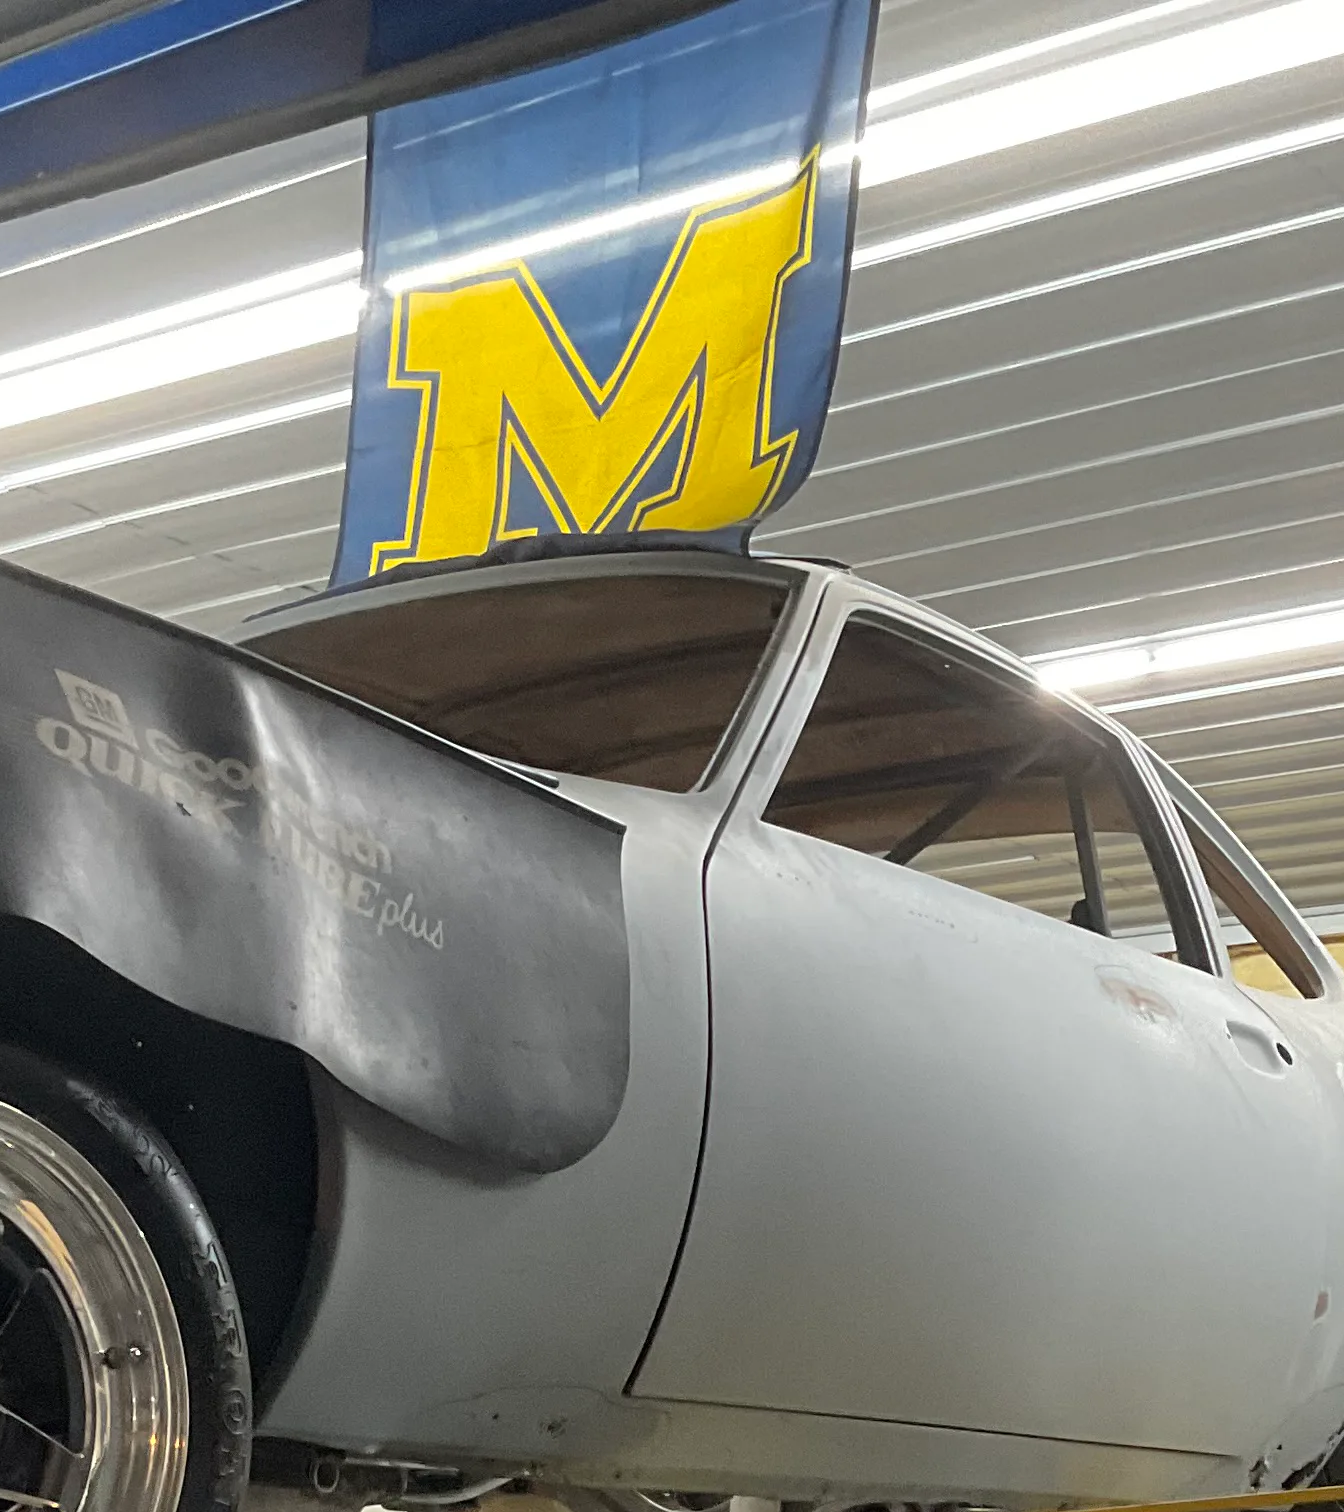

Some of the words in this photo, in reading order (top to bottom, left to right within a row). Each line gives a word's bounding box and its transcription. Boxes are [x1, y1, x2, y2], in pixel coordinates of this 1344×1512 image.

[369, 143, 822, 578] M
[75, 685, 121, 723] GM
[36, 716, 248, 844] QUICK
[376, 892, 444, 950] plus
[145, 727, 393, 875] Gooench
